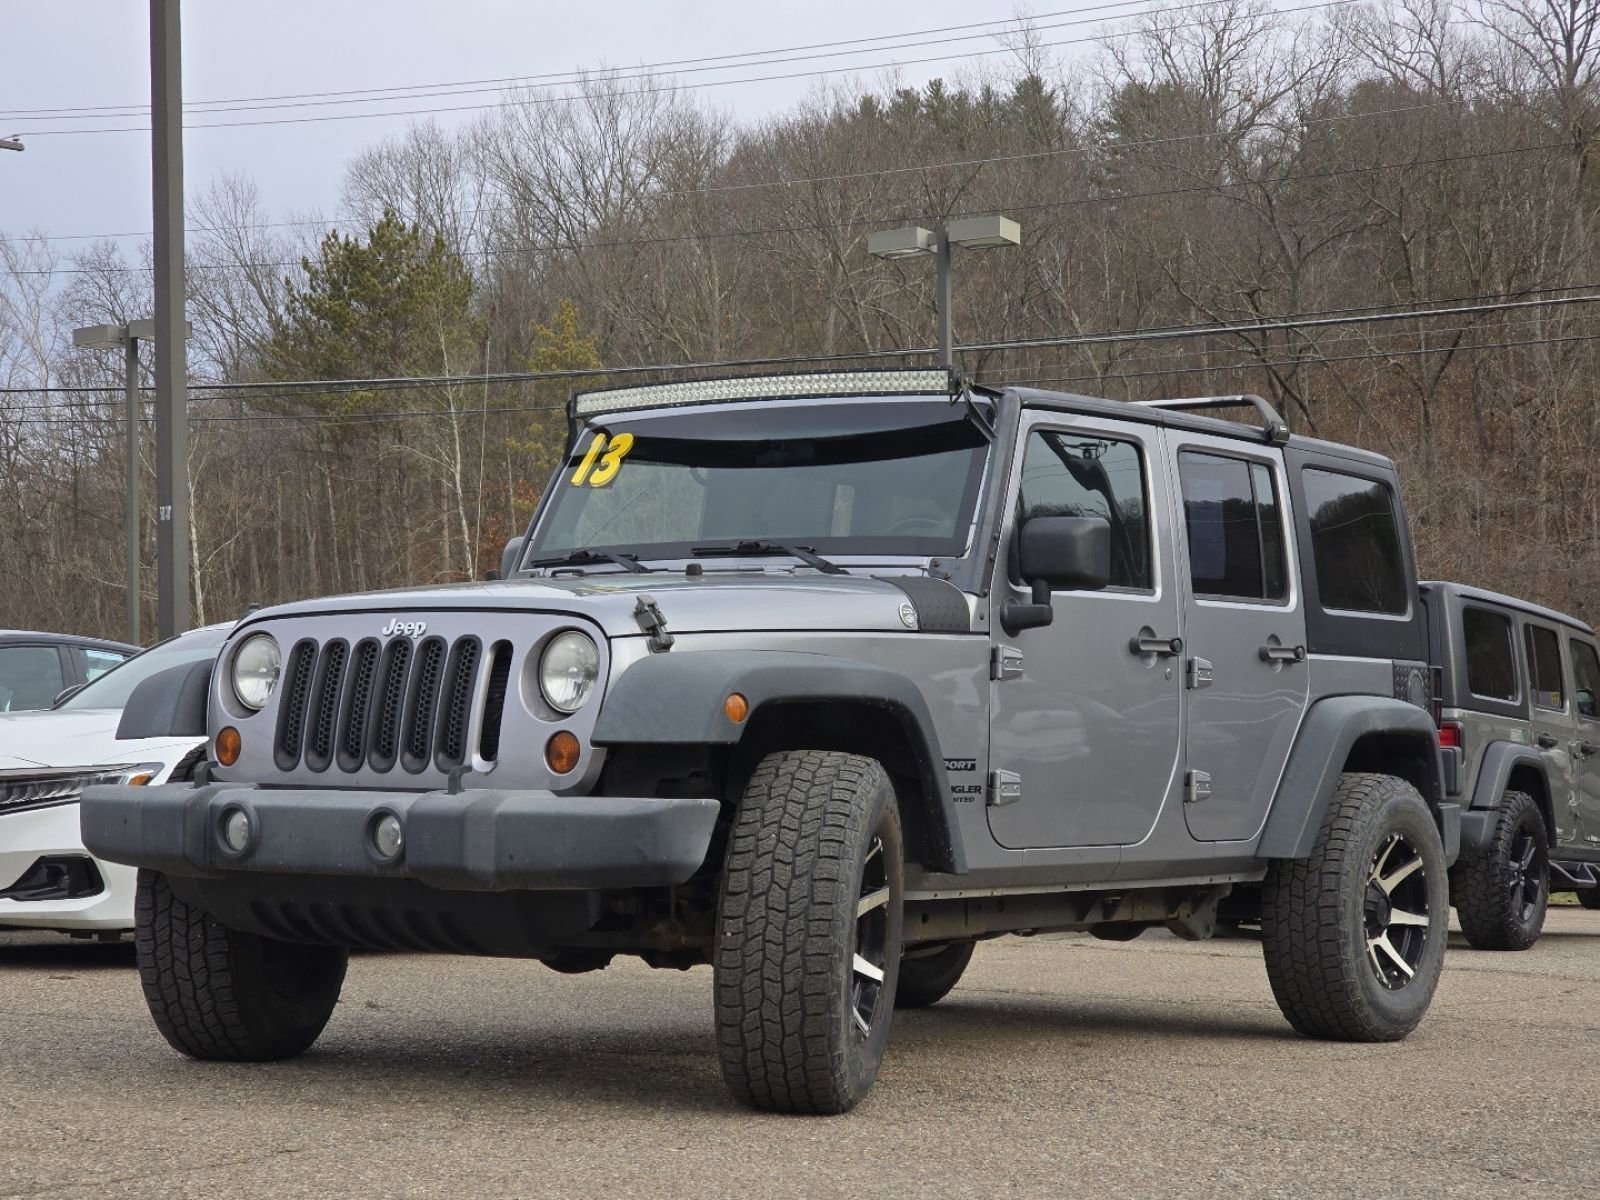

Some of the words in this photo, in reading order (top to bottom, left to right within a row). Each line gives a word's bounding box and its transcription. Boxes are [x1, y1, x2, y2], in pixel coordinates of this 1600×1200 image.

[570, 432, 634, 487] 13
[381, 618, 427, 639] Jeep
[943, 760, 976, 770] PORT
